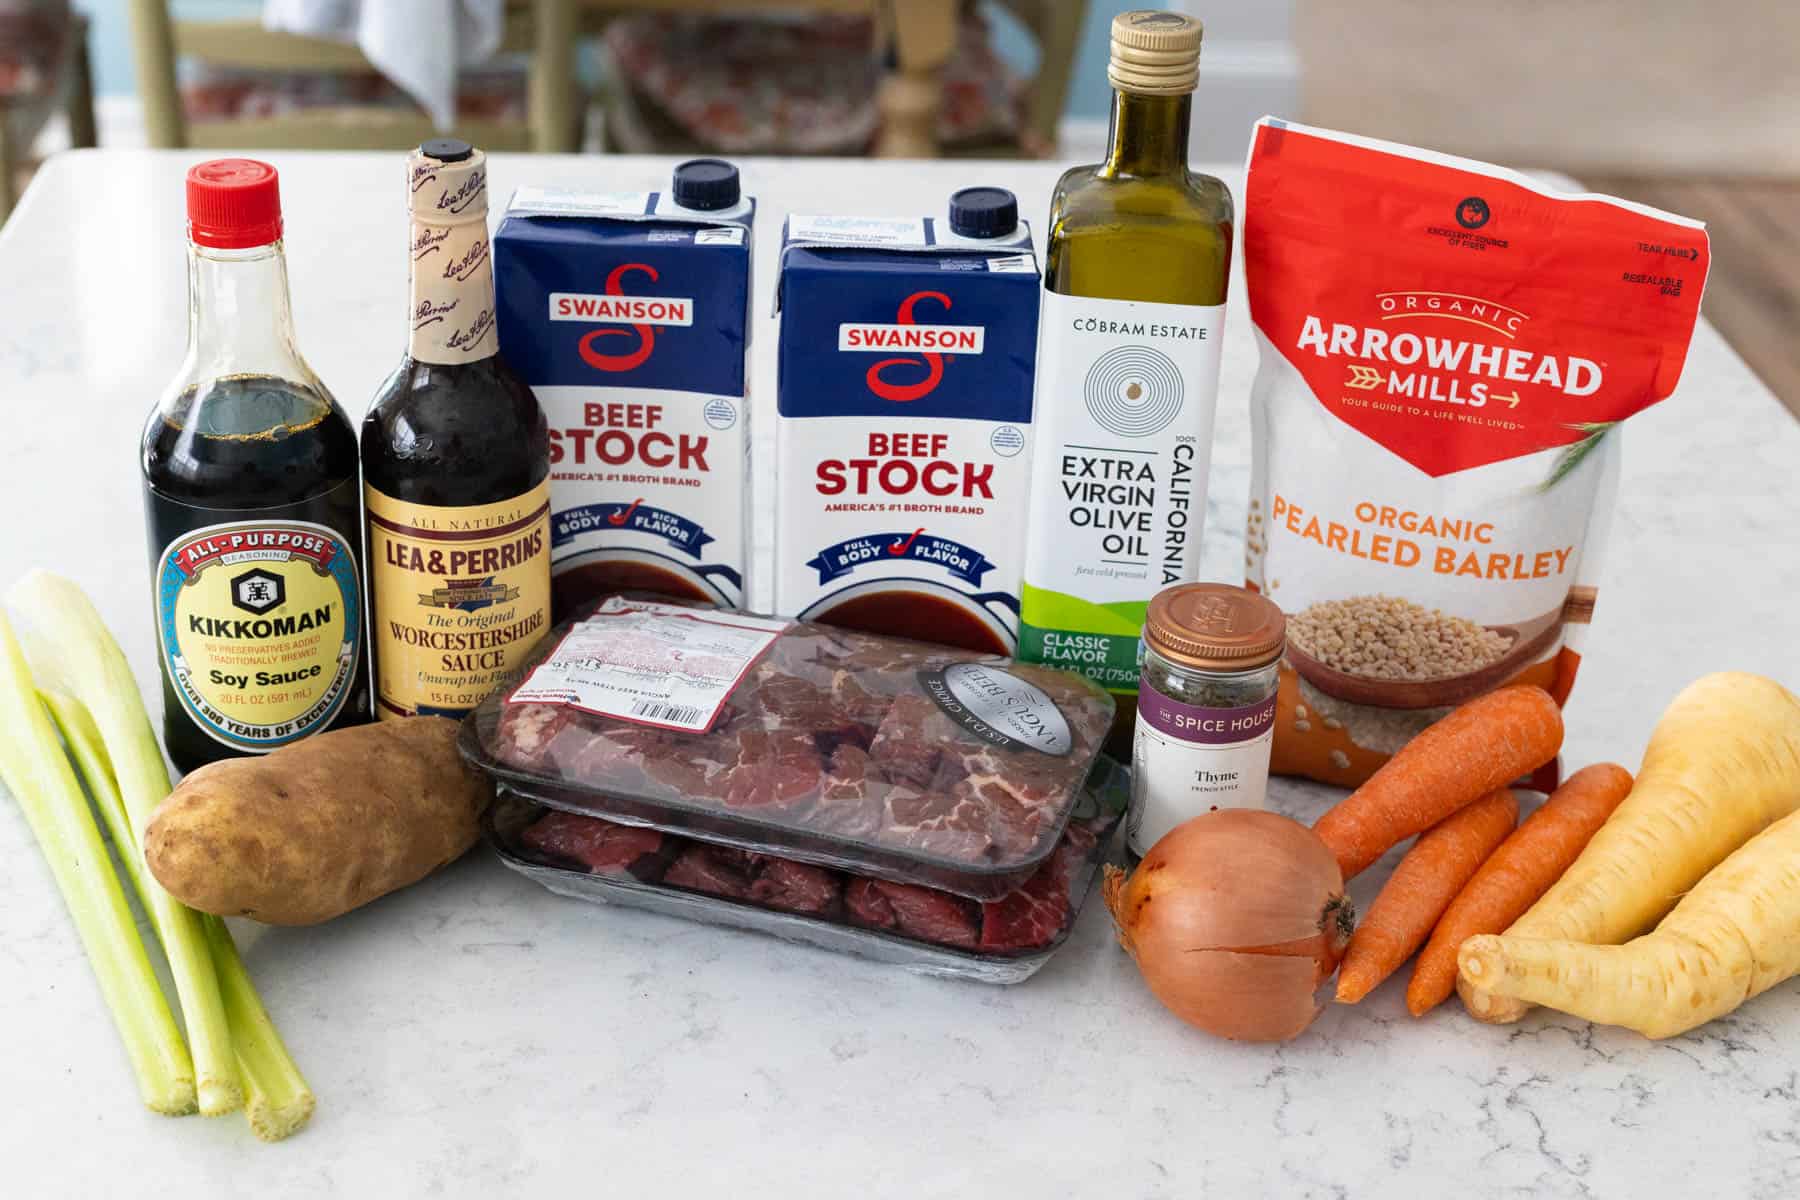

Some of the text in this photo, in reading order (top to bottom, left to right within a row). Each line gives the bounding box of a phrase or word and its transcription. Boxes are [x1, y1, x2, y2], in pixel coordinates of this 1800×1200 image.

[1427, 227, 1508, 248] EXCELLENT SOURCE
[1448, 238, 1460, 247] OF
[1637, 242, 1689, 258] TEAR HERE
[1622, 271, 1684, 288] RESEALABLE
[558, 298, 685, 321] SWANSON
[1380, 296, 1521, 331] ORGANIC
[847, 328, 976, 349] SWANSON
[1150, 324, 1209, 340] ESTATE
[1296, 315, 1603, 397] ARROWHEAD
[1386, 370, 1489, 408] MILLS
[584, 402, 663, 429] BEEF
[1341, 397, 1369, 409] YOUR
[1372, 401, 1403, 413] GUIDE
[1407, 406, 1421, 416] TO
[1423, 408, 1430, 417] A
[1433, 411, 1454, 421] LIFE
[1458, 415, 1483, 425] WELL
[868, 432, 948, 458] BEEF
[1175, 435, 1197, 443] 100%
[547, 429, 711, 472] STOCK
[816, 459, 995, 500] STOCK
[1062, 455, 1156, 483] EXTRA
[550, 472, 701, 488] MERICA'S #1 BROTH BRAND
[1062, 481, 1155, 508] VIRGIN
[409, 509, 523, 530] ALL NATURAL
[564, 509, 592, 521] FULL
[652, 511, 679, 525] RICH
[824, 503, 985, 515] AMERICA'S #1 BROTH BRAND
[1069, 507, 1153, 532] OLIVE
[1161, 444, 1195, 585] CALIFORNIA
[558, 515, 601, 534] BODY
[634, 516, 690, 542] FLAVOR
[1354, 502, 1496, 545] ORGANIC
[187, 532, 325, 562] ALL-PURPOSE
[844, 539, 872, 552] FULL
[932, 540, 959, 554] RICH
[1102, 534, 1149, 556] OIL
[1272, 495, 1574, 580] PEARLED BARLEY
[224, 550, 290, 562] SEASONING
[838, 546, 881, 566] BODY
[914, 546, 970, 571] FLAVOR
[189, 603, 332, 640] KIKKOMAN
[389, 607, 545, 651] WORCESTERSHIRE
[426, 608, 517, 629] The Original
[219, 642, 291, 655] PRESERVATIVES
[293, 635, 321, 650] ADDED
[1043, 632, 1111, 651] CLASSIC
[209, 647, 318, 666] TRADITIONALLY BREWED
[441, 649, 506, 672] SAUCE
[1042, 645, 1107, 663] FLAVOR
[209, 664, 322, 690] Soy Sauce
[417, 670, 466, 689] Unwrap
[467, 670, 488, 685] the
[1086, 666, 1105, 680] OZ
[178, 659, 349, 739] OVER 300 YEARS OF EXCELLENCE
[220, 694, 232, 705] 20
[235, 694, 247, 705] FL
[250, 694, 265, 705] OZ
[268, 692, 289, 705] (591
[431, 692, 442, 703] 15
[444, 693, 455, 704] FL
[459, 693, 474, 704] OZ
[927, 679, 962, 713] CHOICE
[1006, 696, 1058, 746] ANGUS
[1160, 704, 1275, 732] THE SPICE HOUSE
[1195, 769, 1239, 785] Thyme
[1191, 784, 1240, 793] FRENCH STYLE
